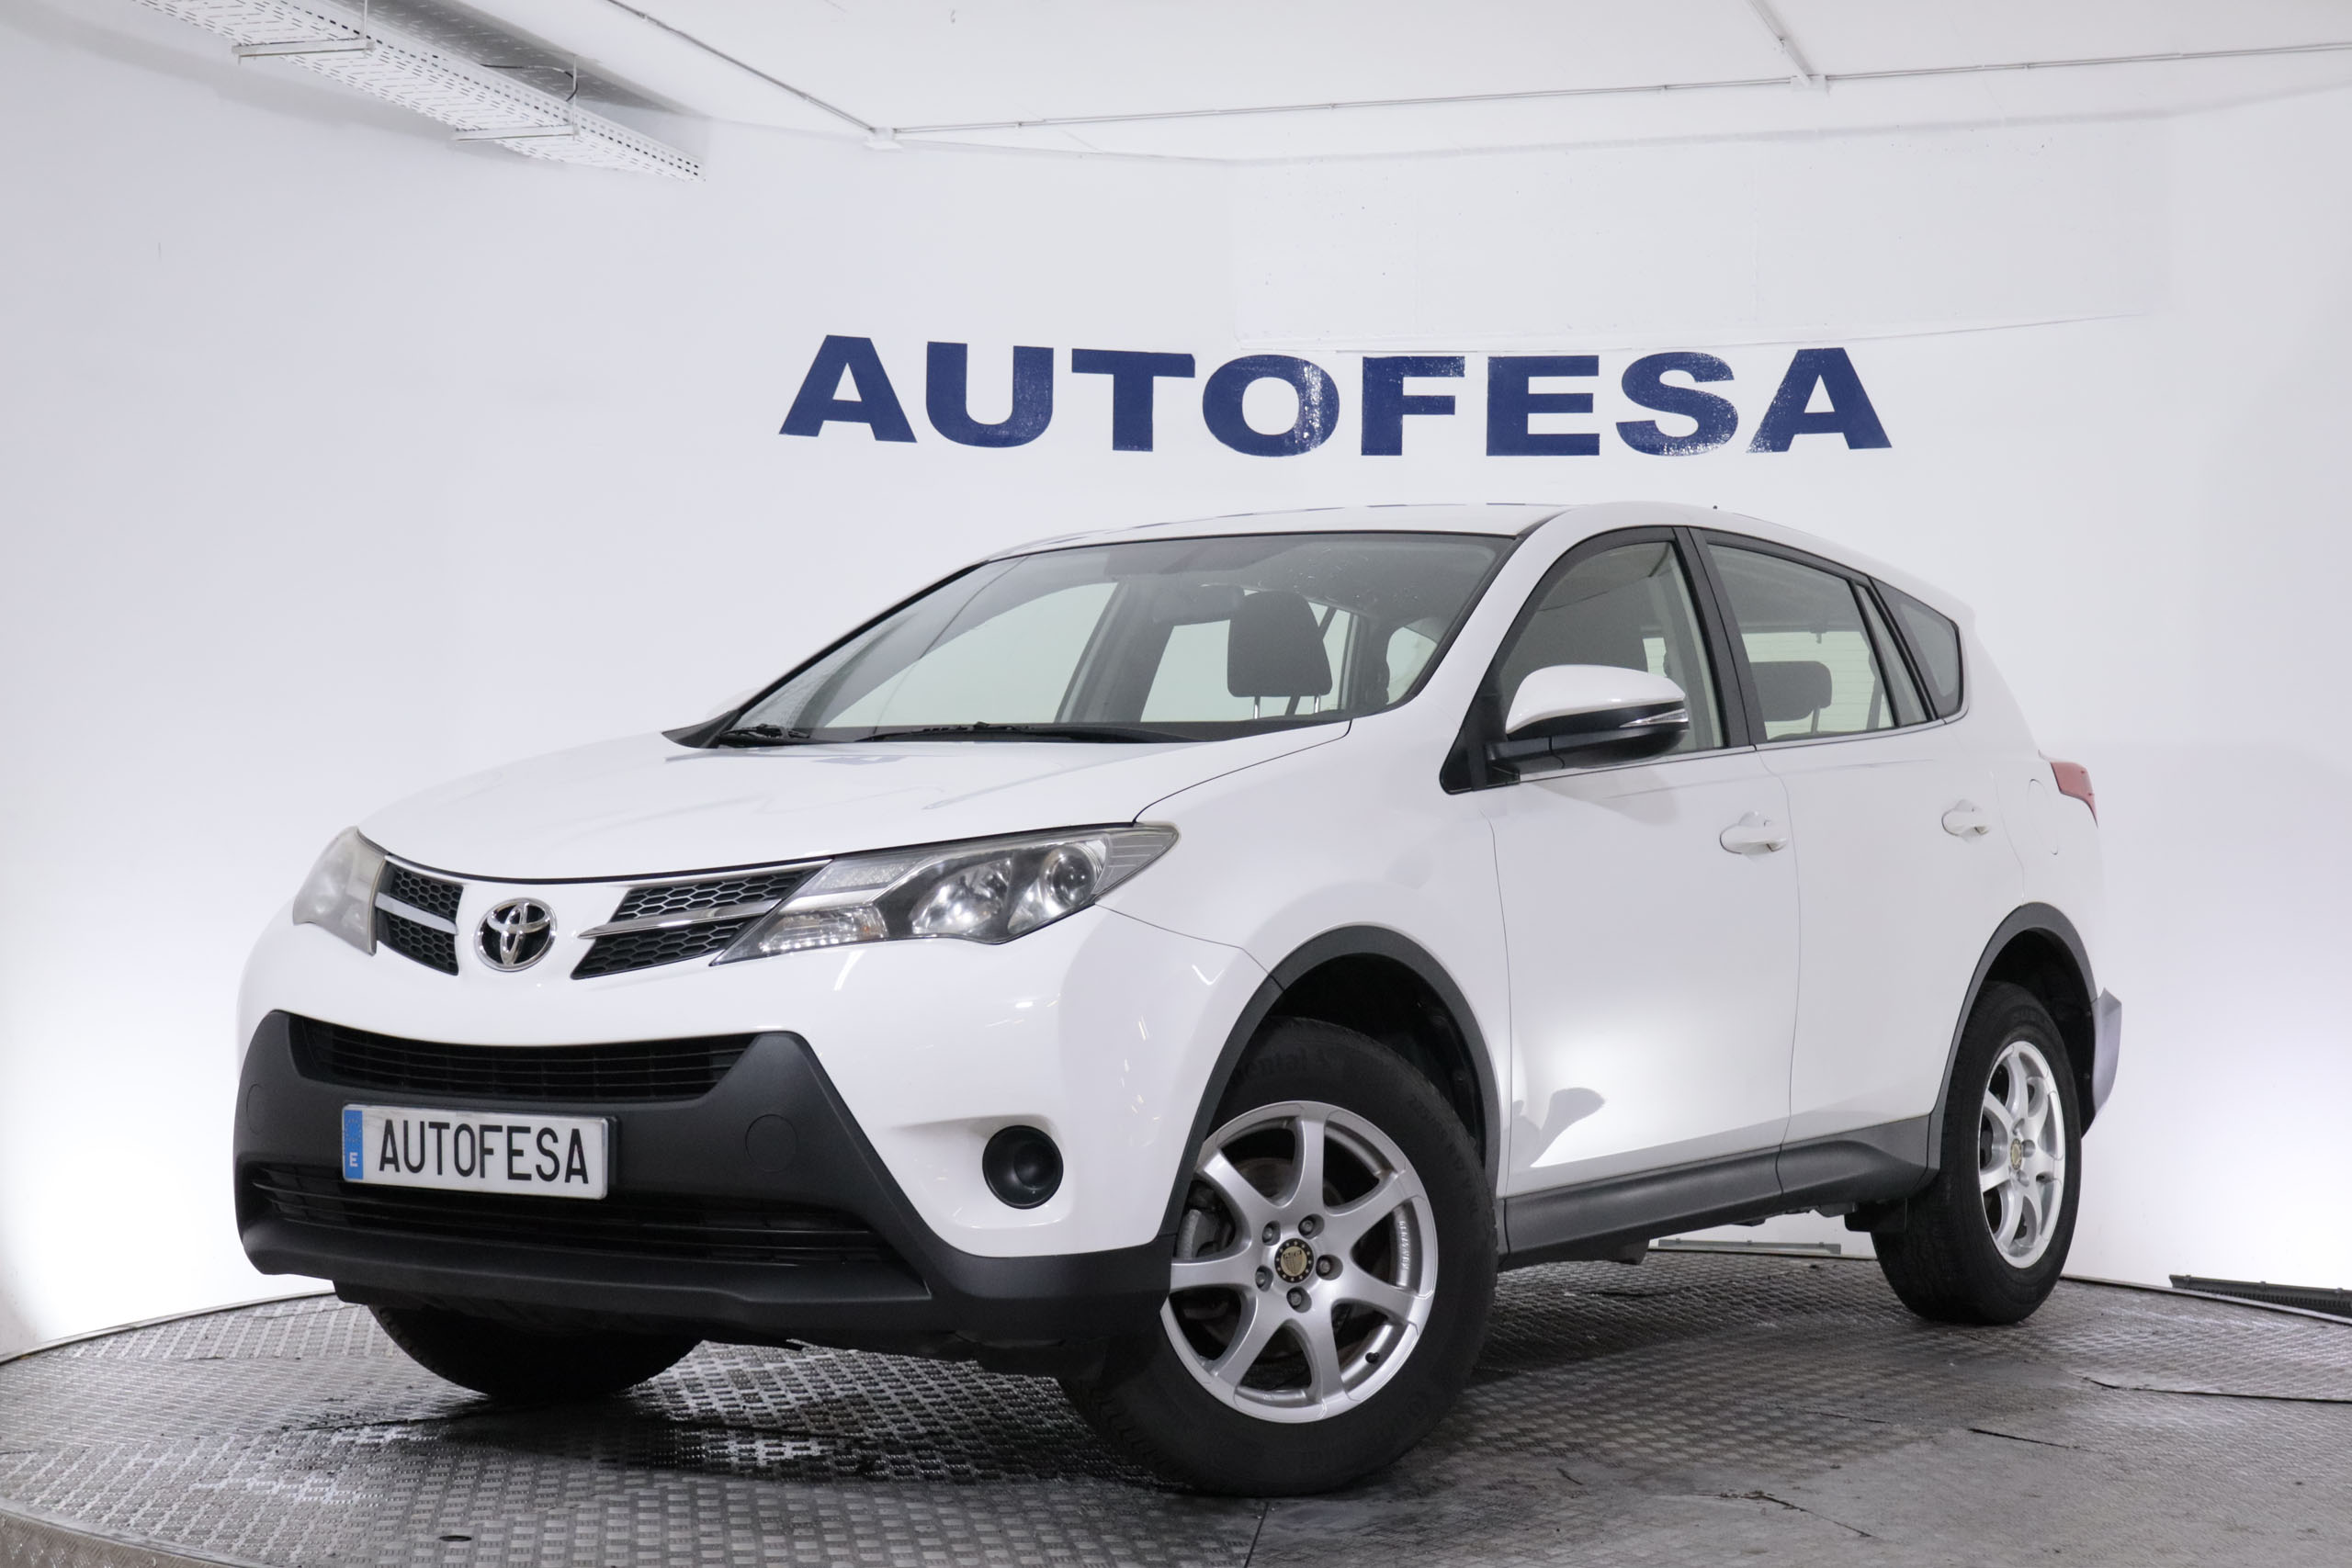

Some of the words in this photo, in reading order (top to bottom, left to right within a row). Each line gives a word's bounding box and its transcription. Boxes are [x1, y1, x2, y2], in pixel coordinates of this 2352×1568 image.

[778, 333, 1893, 457] AUTOFESA
[349, 1152, 359, 1168] E
[378, 1118, 590, 1185] AUTOFESA
